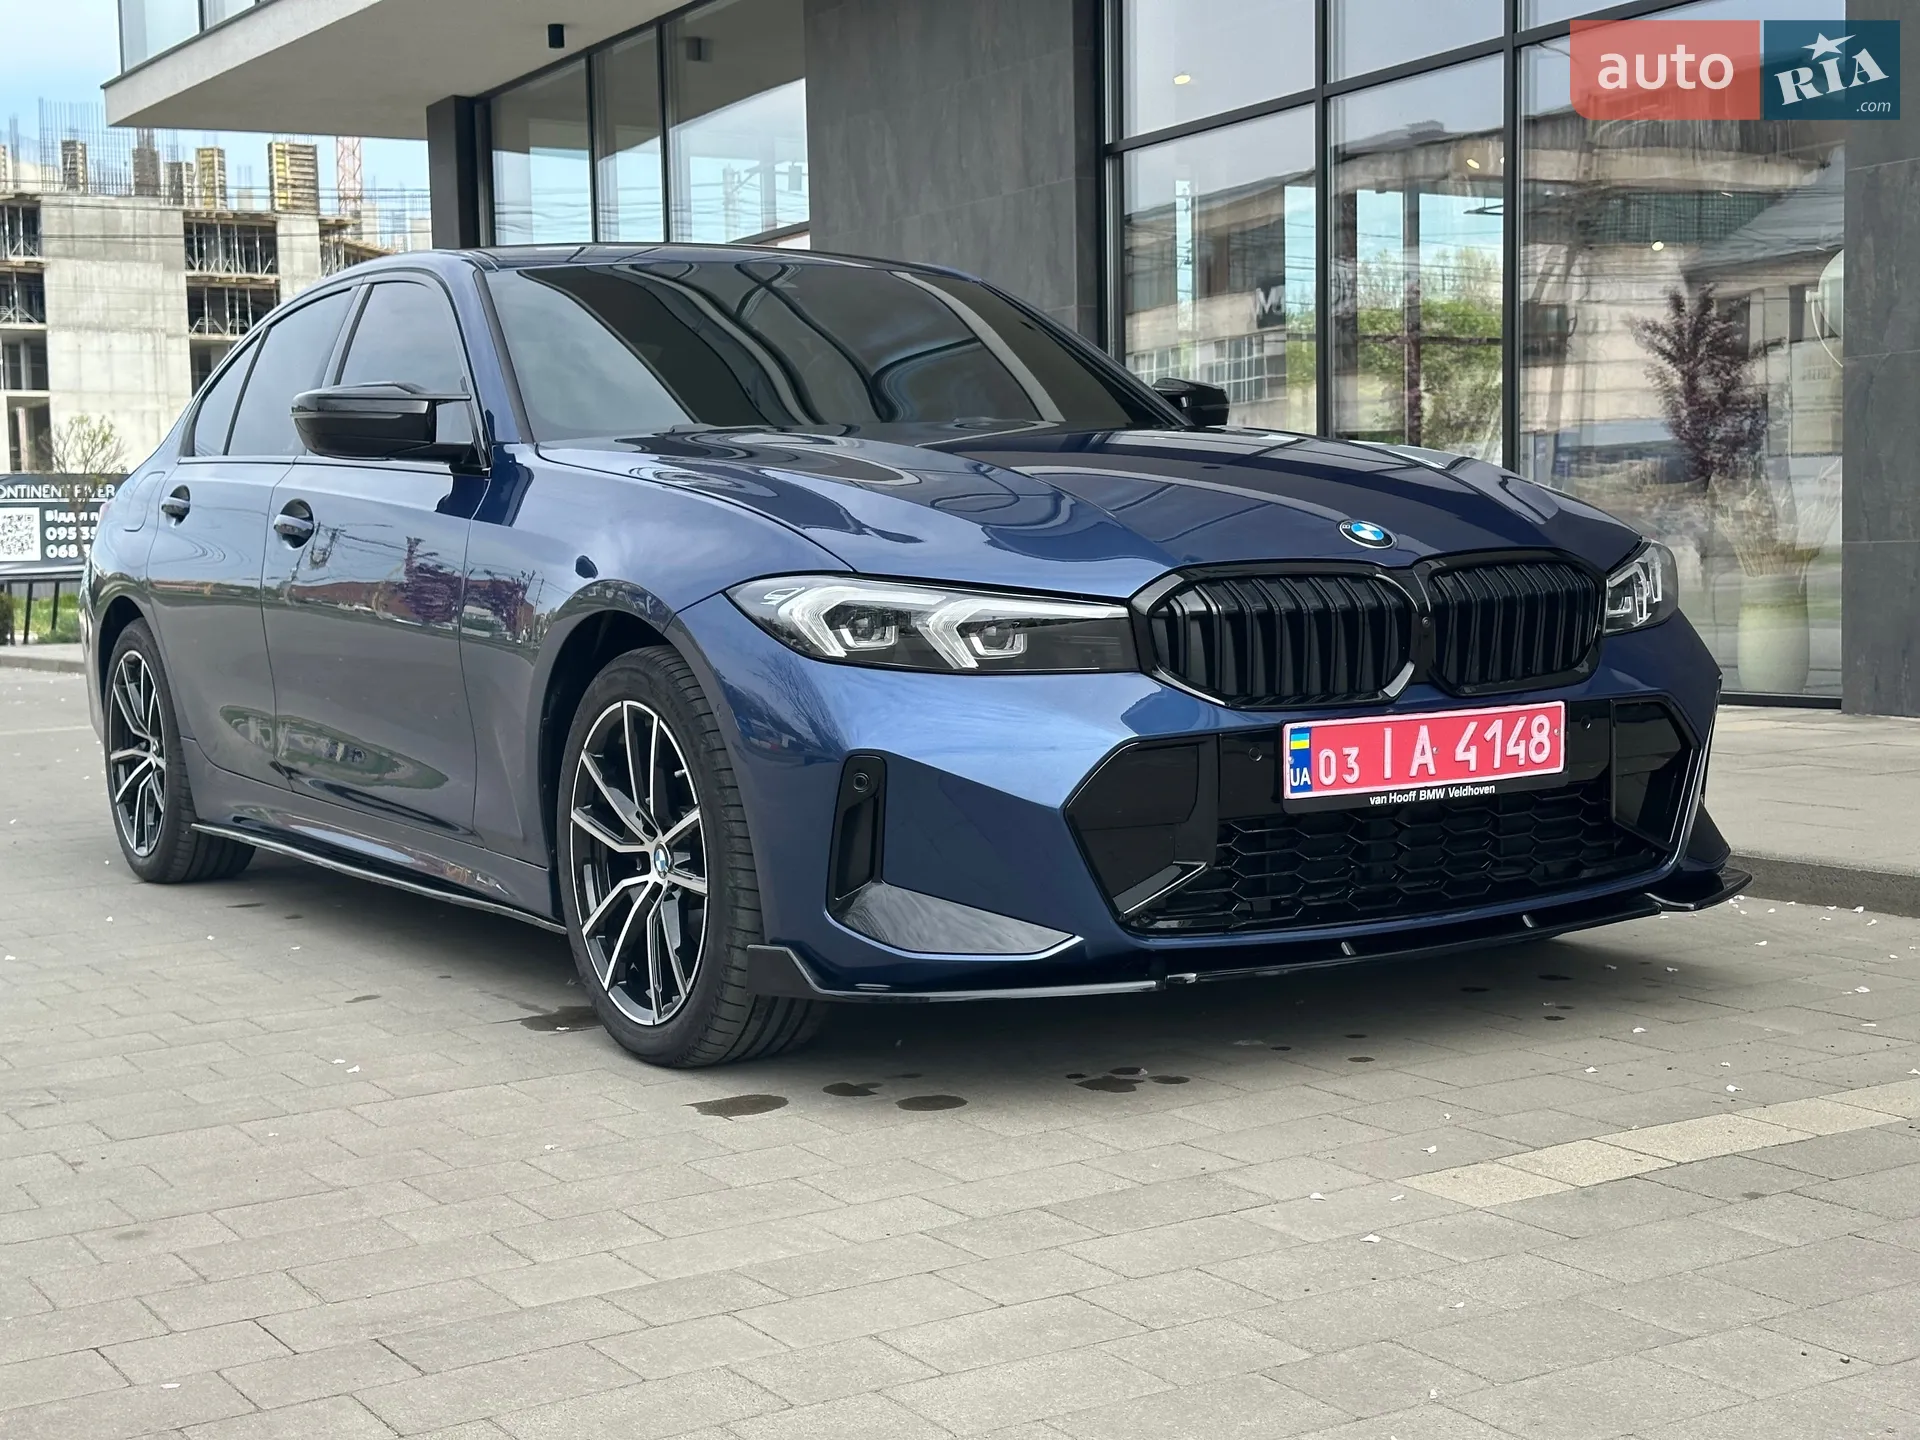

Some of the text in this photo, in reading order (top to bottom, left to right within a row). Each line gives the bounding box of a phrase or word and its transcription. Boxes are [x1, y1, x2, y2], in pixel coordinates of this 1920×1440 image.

[45, 526, 77, 541] 095
[46, 543, 79, 559] 068
[1290, 767, 1311, 787] UA
[1318, 747, 1360, 786] 03
[1454, 714, 1551, 772] 4148
[1369, 785, 1496, 806] van Hooff BMW Veldhoven
